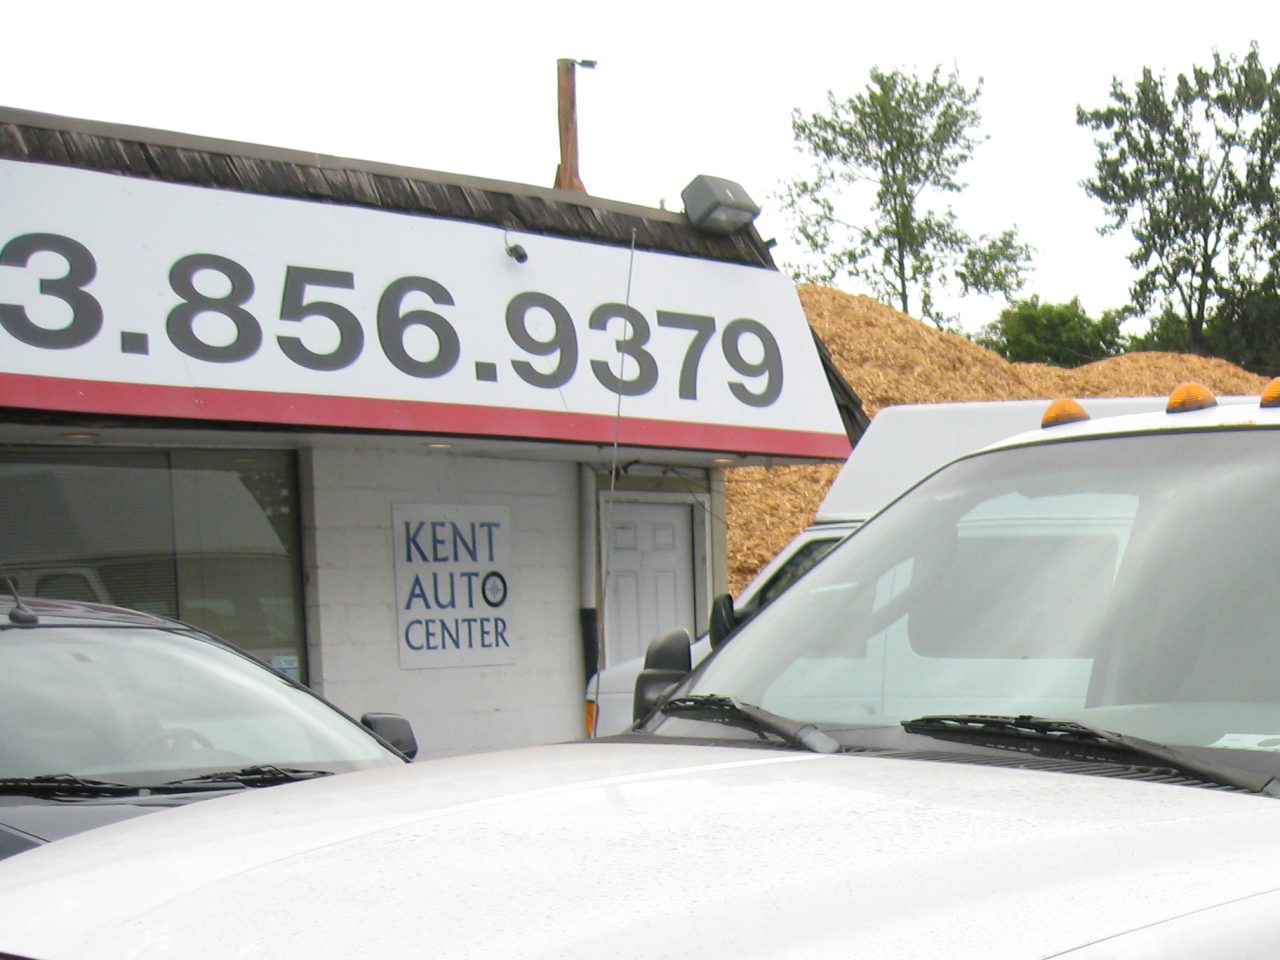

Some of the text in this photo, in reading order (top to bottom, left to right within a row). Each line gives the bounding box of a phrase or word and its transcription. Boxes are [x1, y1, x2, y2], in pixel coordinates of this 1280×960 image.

[0, 232, 785, 408] 3.856.9379
[404, 521, 501, 562] KENT
[404, 570, 508, 610] AUTO
[404, 617, 510, 651] CENTER
